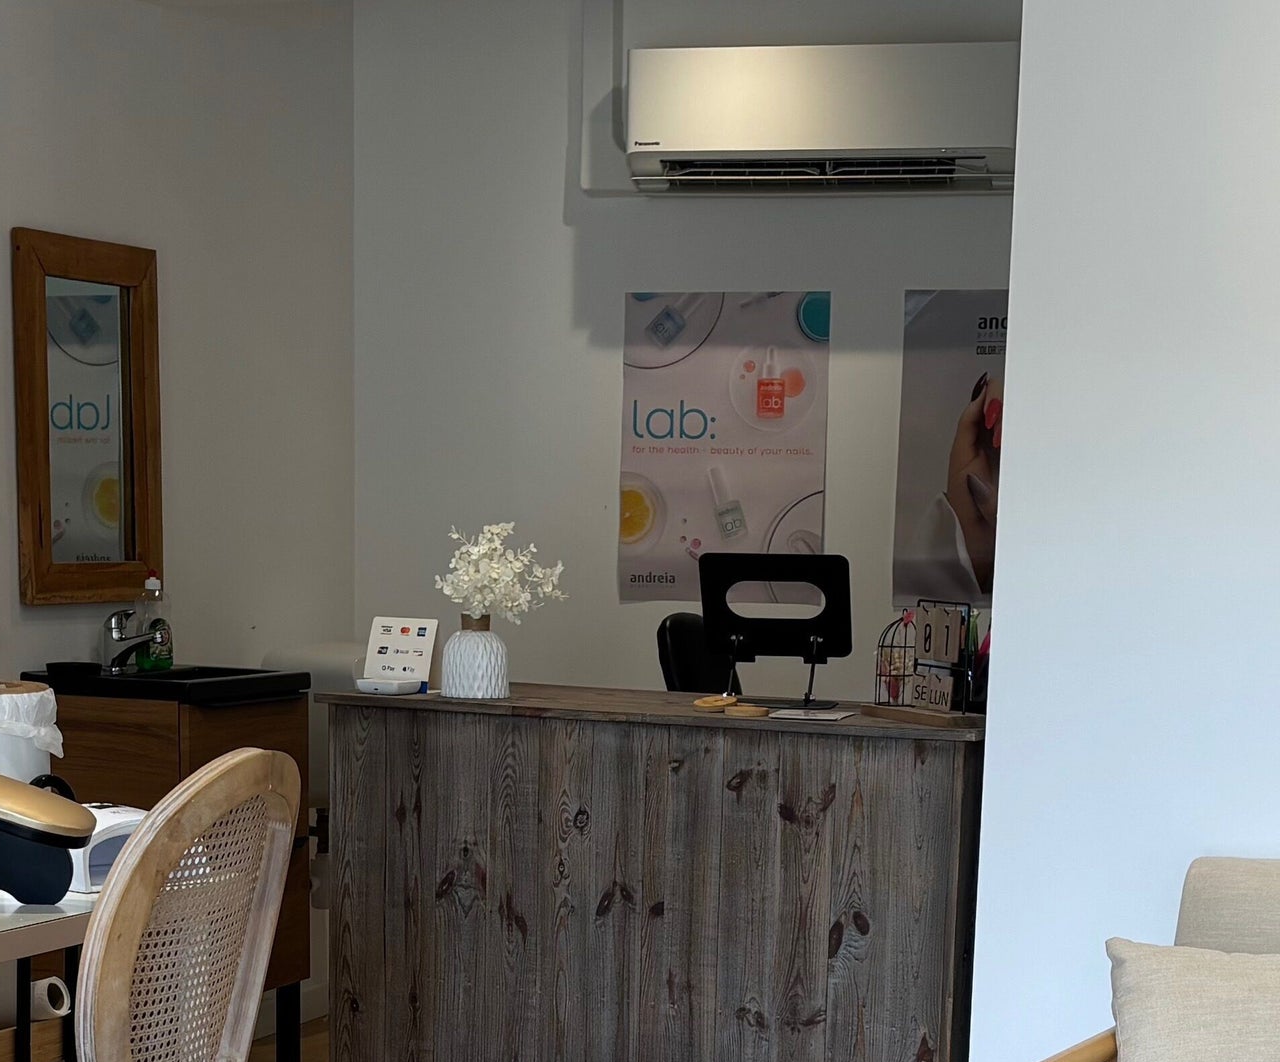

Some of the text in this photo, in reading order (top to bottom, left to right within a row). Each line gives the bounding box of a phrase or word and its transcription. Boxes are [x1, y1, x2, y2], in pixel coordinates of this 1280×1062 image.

[632, 399, 716, 440] lab:
[632, 446, 645, 454] for
[648, 446, 664, 454] the
[669, 446, 700, 454] health
[710, 446, 743, 456] beauty
[747, 446, 756, 455] of
[760, 448, 783, 457] your
[630, 571, 676, 584] andreia
